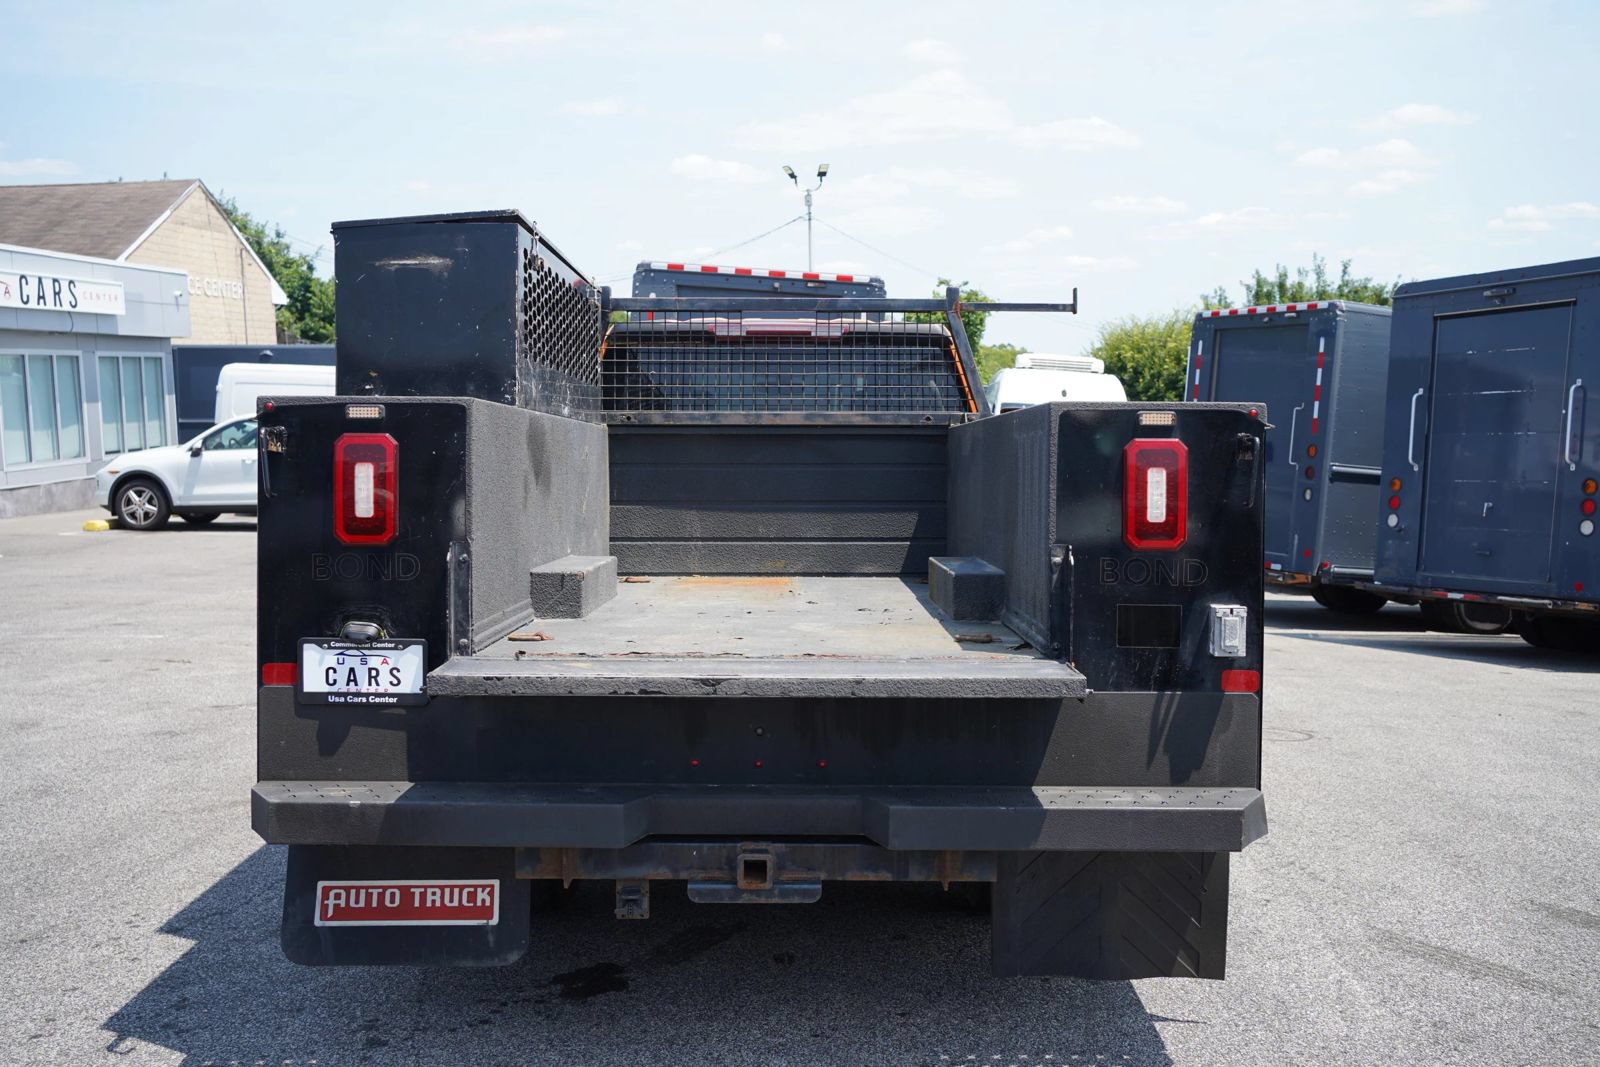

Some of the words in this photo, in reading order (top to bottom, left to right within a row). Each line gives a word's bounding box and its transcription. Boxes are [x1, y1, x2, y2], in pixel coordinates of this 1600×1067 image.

[19, 275, 78, 308] CARS
[83, 290, 118, 302] CENTER
[204, 278, 243, 300] CENTER
[312, 553, 421, 581] BOND
[1100, 557, 1209, 587] BOND
[325, 667, 402, 687] CARS
[328, 695, 345, 703] Usa
[346, 695, 367, 703] Cars
[368, 695, 398, 703] Center
[324, 888, 400, 918] AUTO
[410, 887, 492, 907] TRUCK
